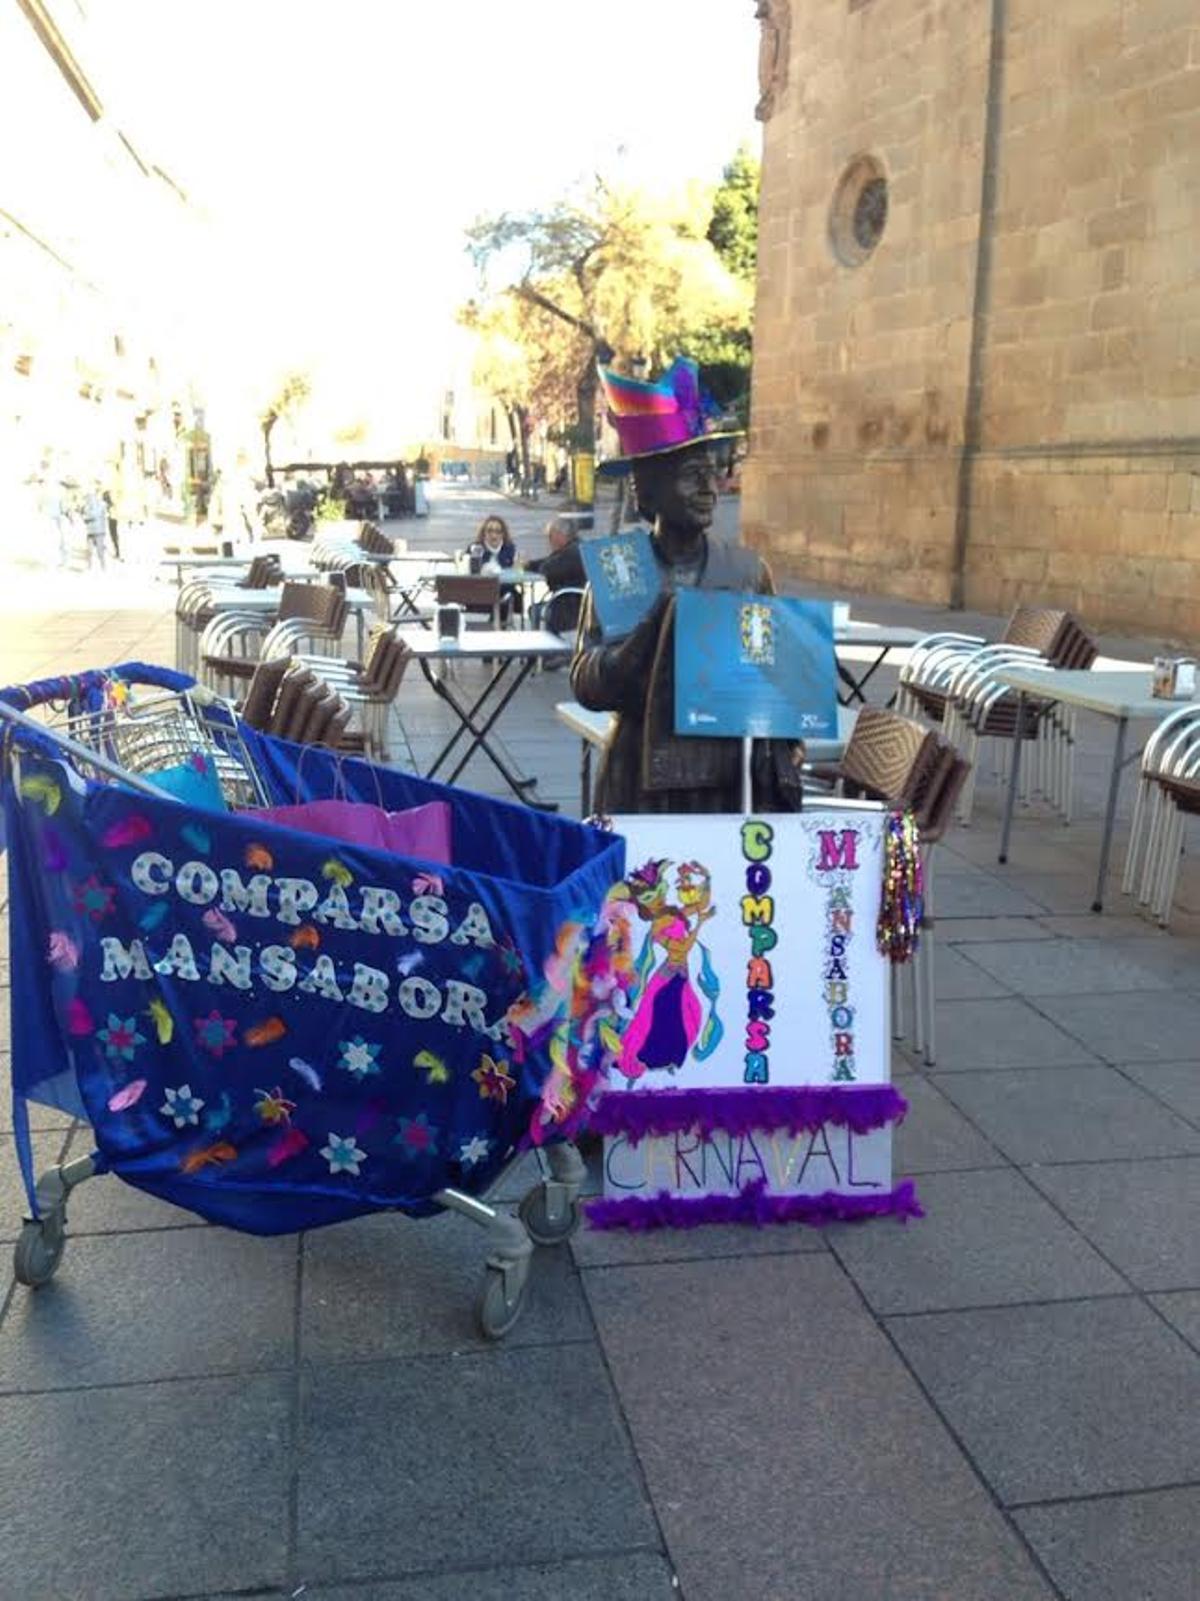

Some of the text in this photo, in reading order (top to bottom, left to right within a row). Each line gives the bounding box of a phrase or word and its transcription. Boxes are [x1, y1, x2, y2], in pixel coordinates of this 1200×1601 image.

[131, 851, 498, 947] COMPARSA
[739, 821, 778, 1084] COMPARSA
[814, 829, 860, 1082] MANSABORA
